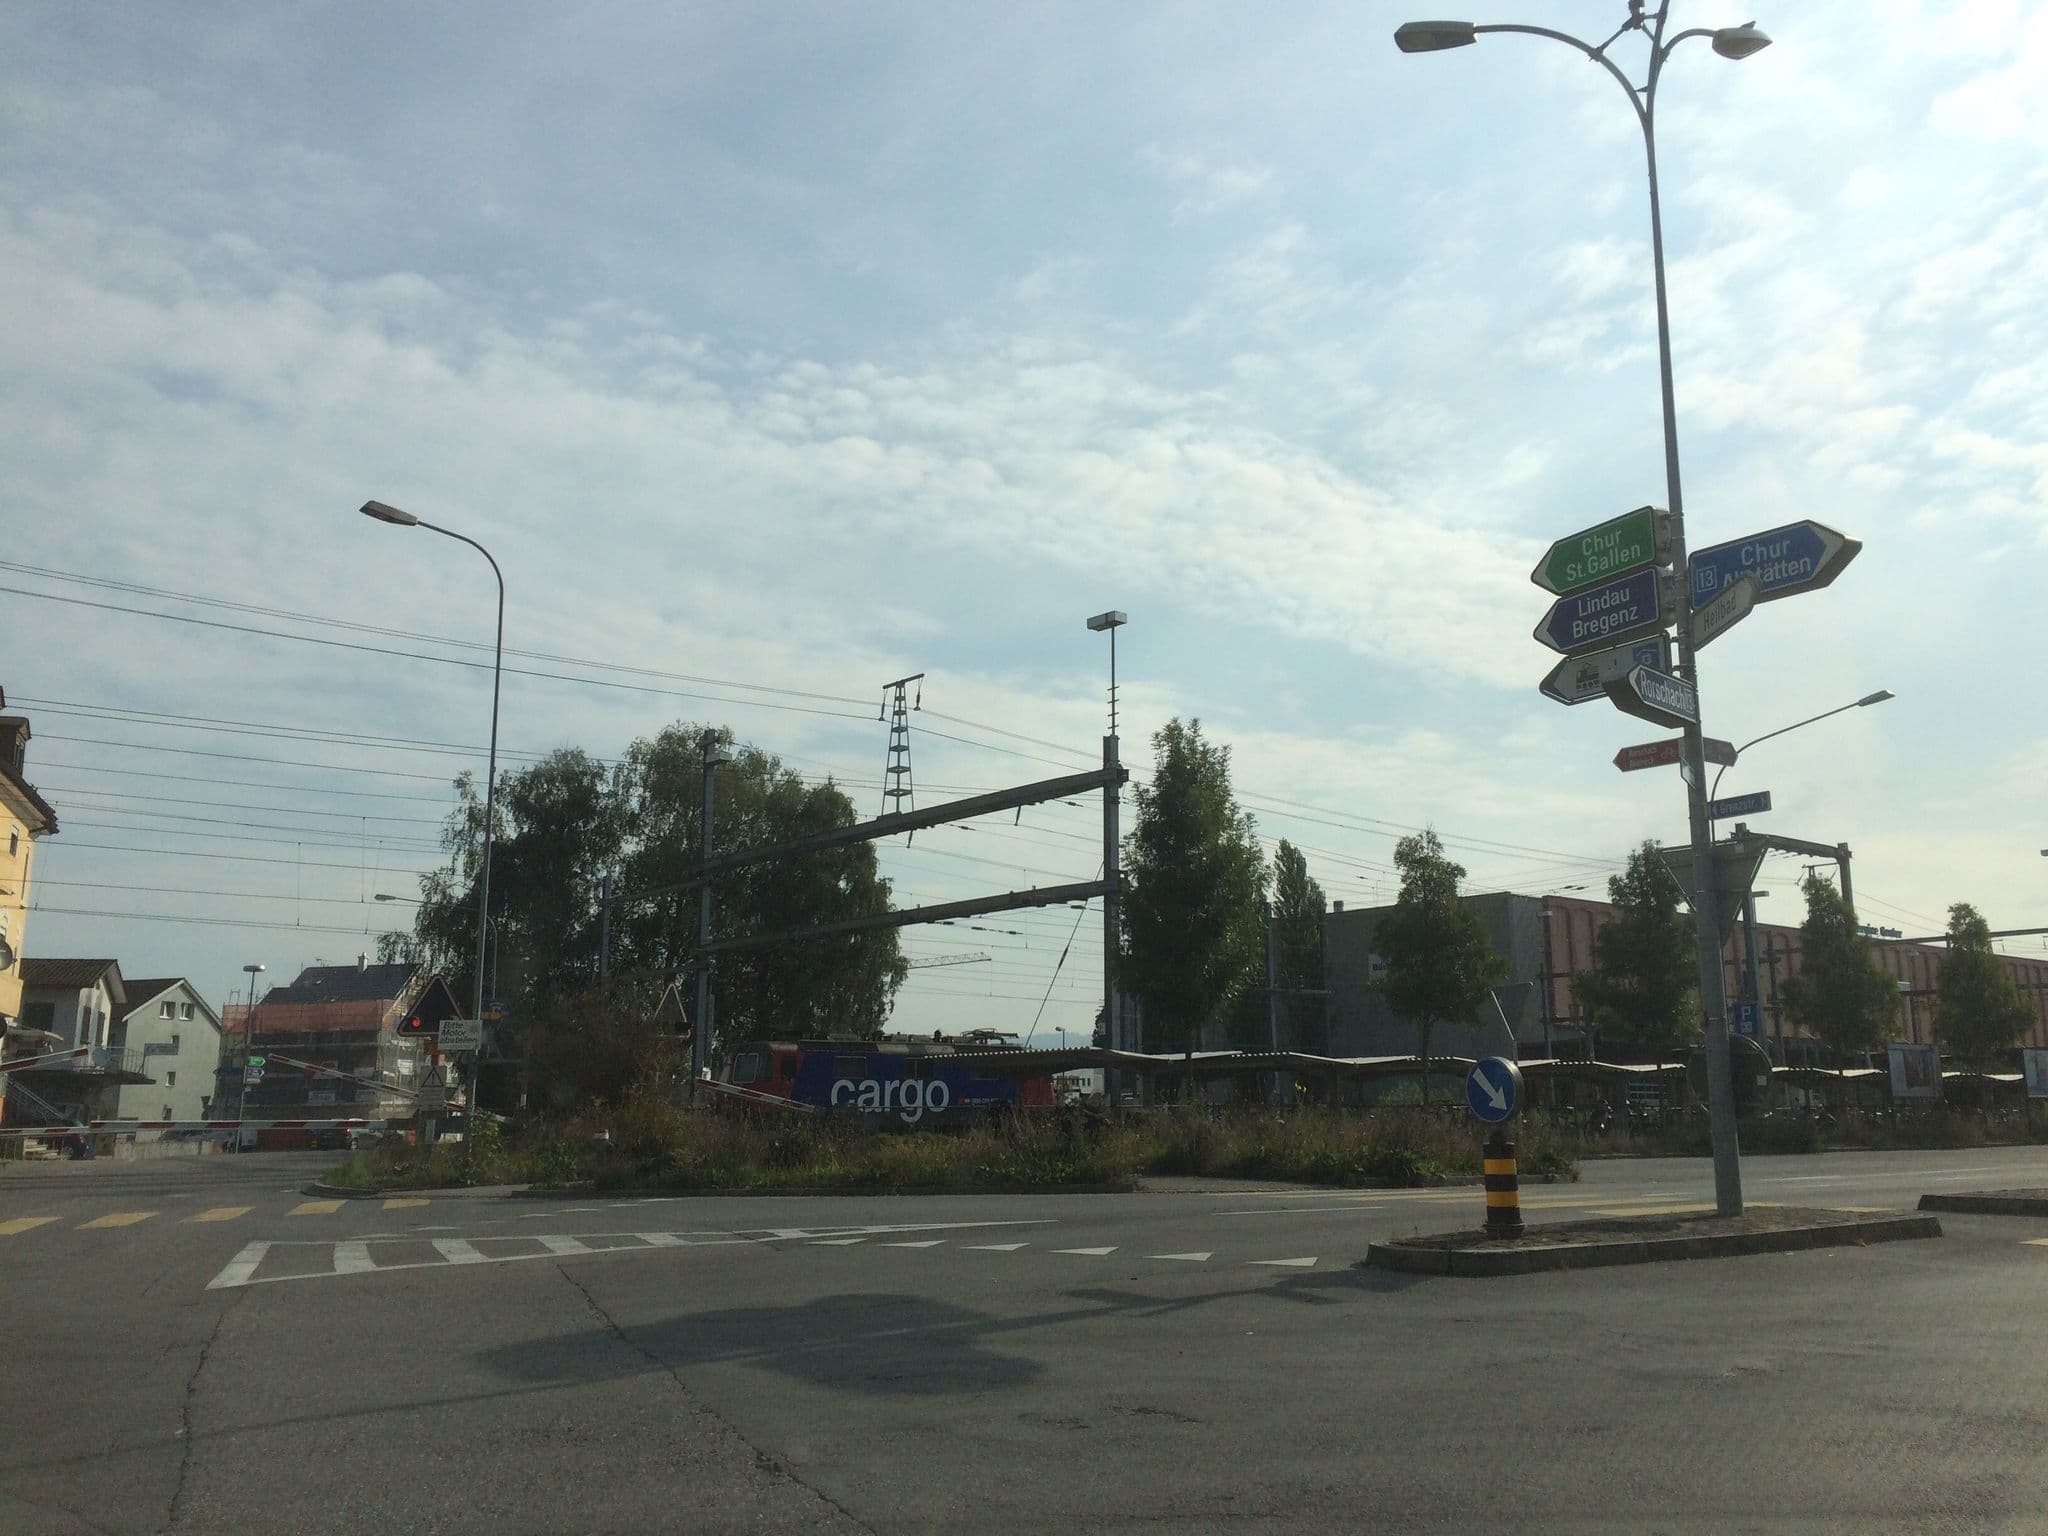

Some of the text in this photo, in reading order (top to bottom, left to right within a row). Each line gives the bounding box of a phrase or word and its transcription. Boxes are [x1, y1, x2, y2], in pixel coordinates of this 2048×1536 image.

[1582, 530, 1622, 555] Chur
[1741, 540, 1791, 565] Chur
[1566, 544, 1641, 581] St.Gallen
[1700, 570, 1714, 588] 13
[1578, 588, 1630, 617] Lindau
[1704, 594, 1737, 631] Heilbad
[1572, 606, 1639, 639] Bregenz
[1640, 669, 1685, 709] Rorschach
[831, 1079, 950, 1122] cargo
